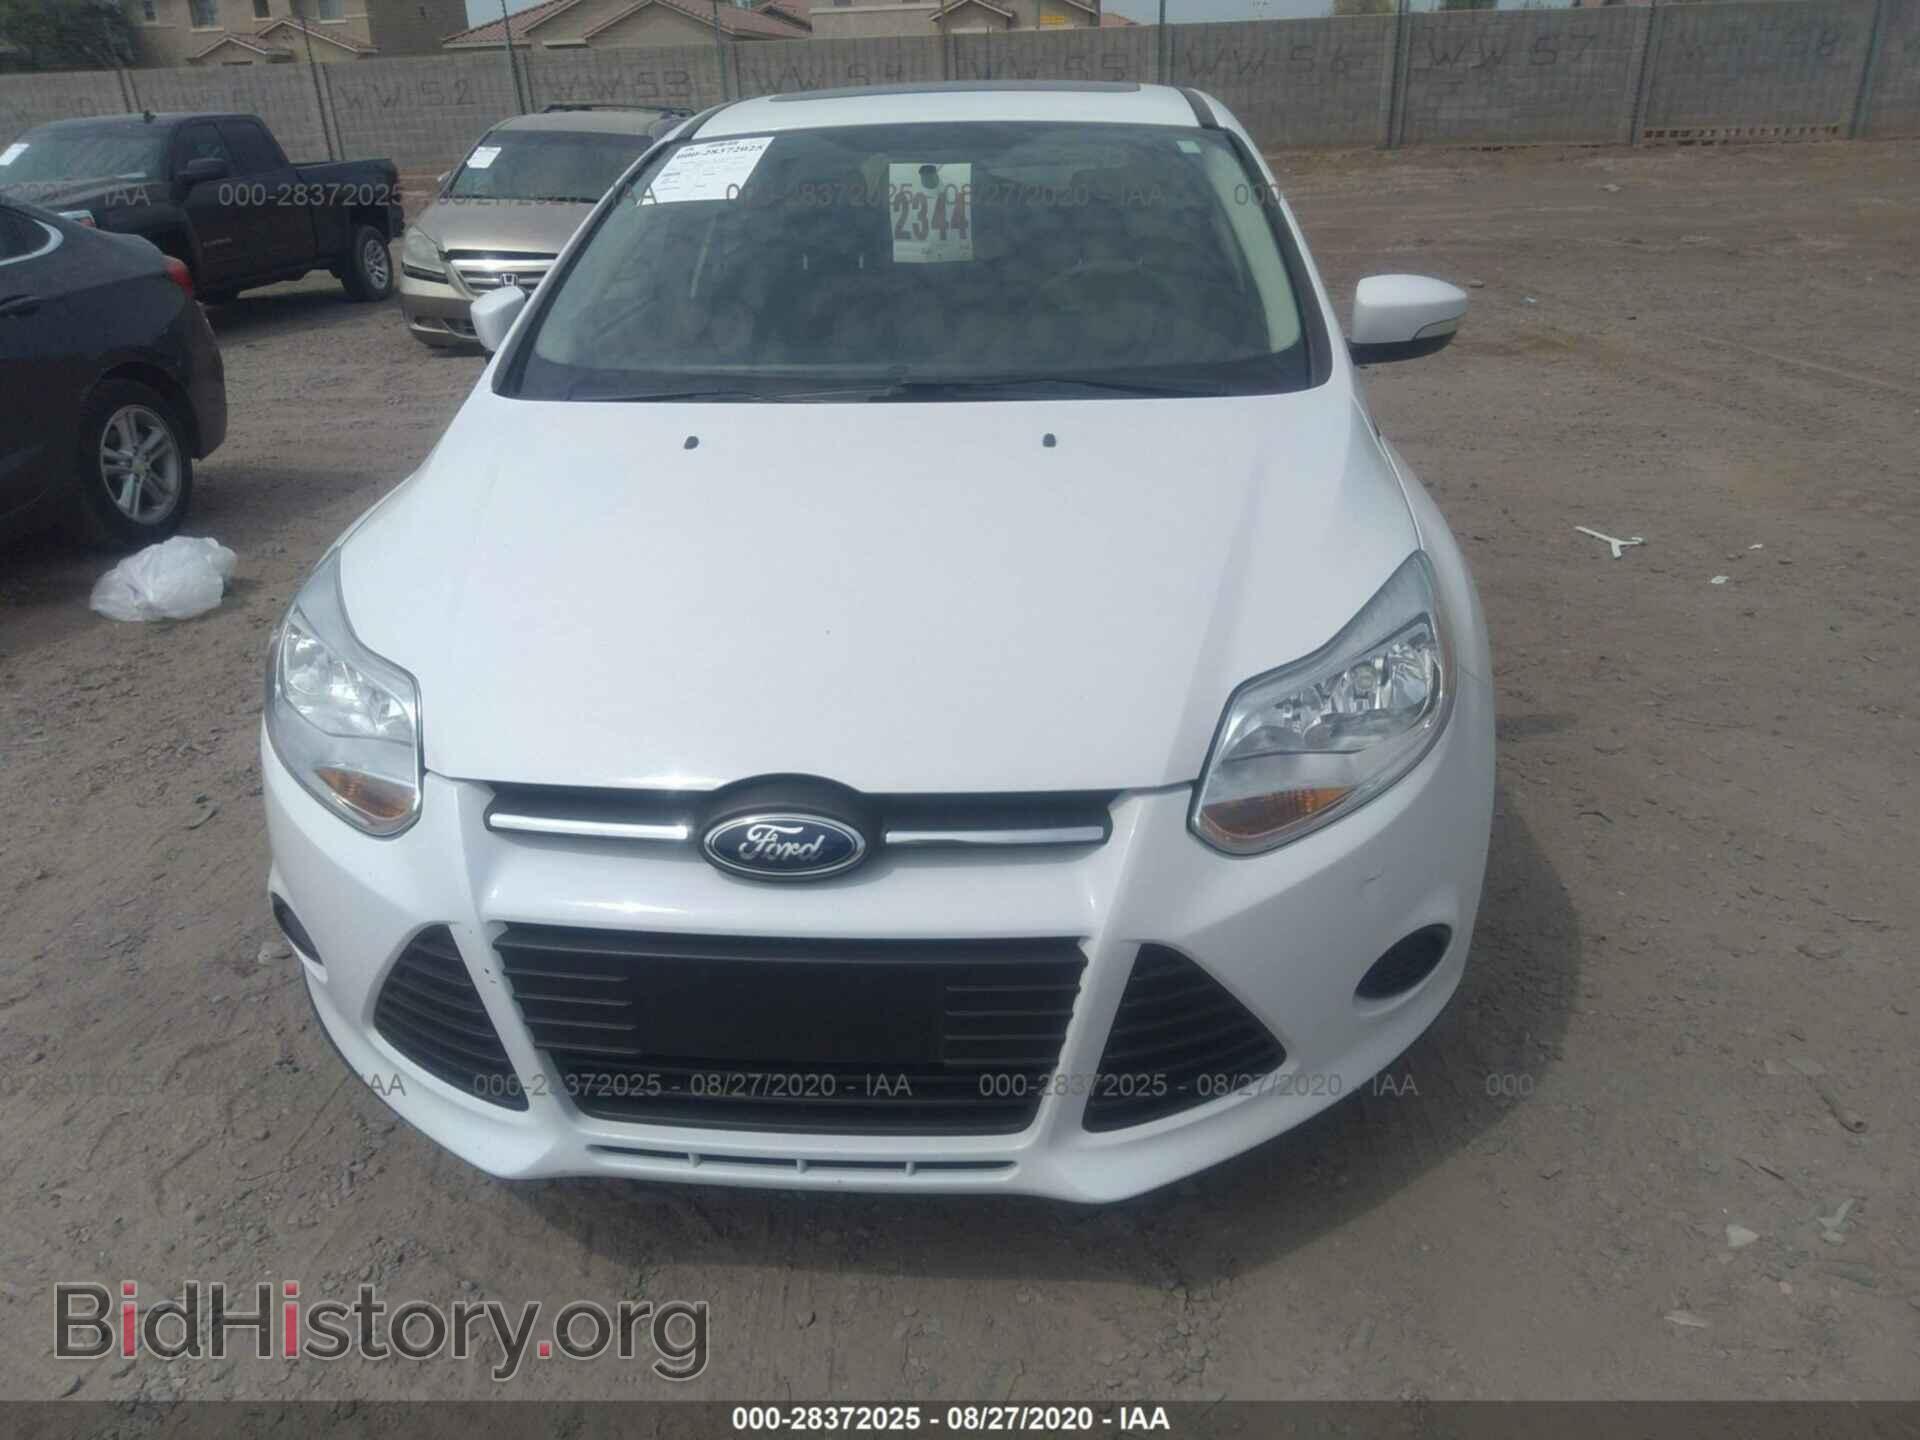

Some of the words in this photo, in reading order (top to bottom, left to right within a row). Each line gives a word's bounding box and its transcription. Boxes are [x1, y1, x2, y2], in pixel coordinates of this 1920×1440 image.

[1530, 34, 1597, 66] 57
[893, 192, 969, 241] 2344
[738, 823, 825, 861] Ford
